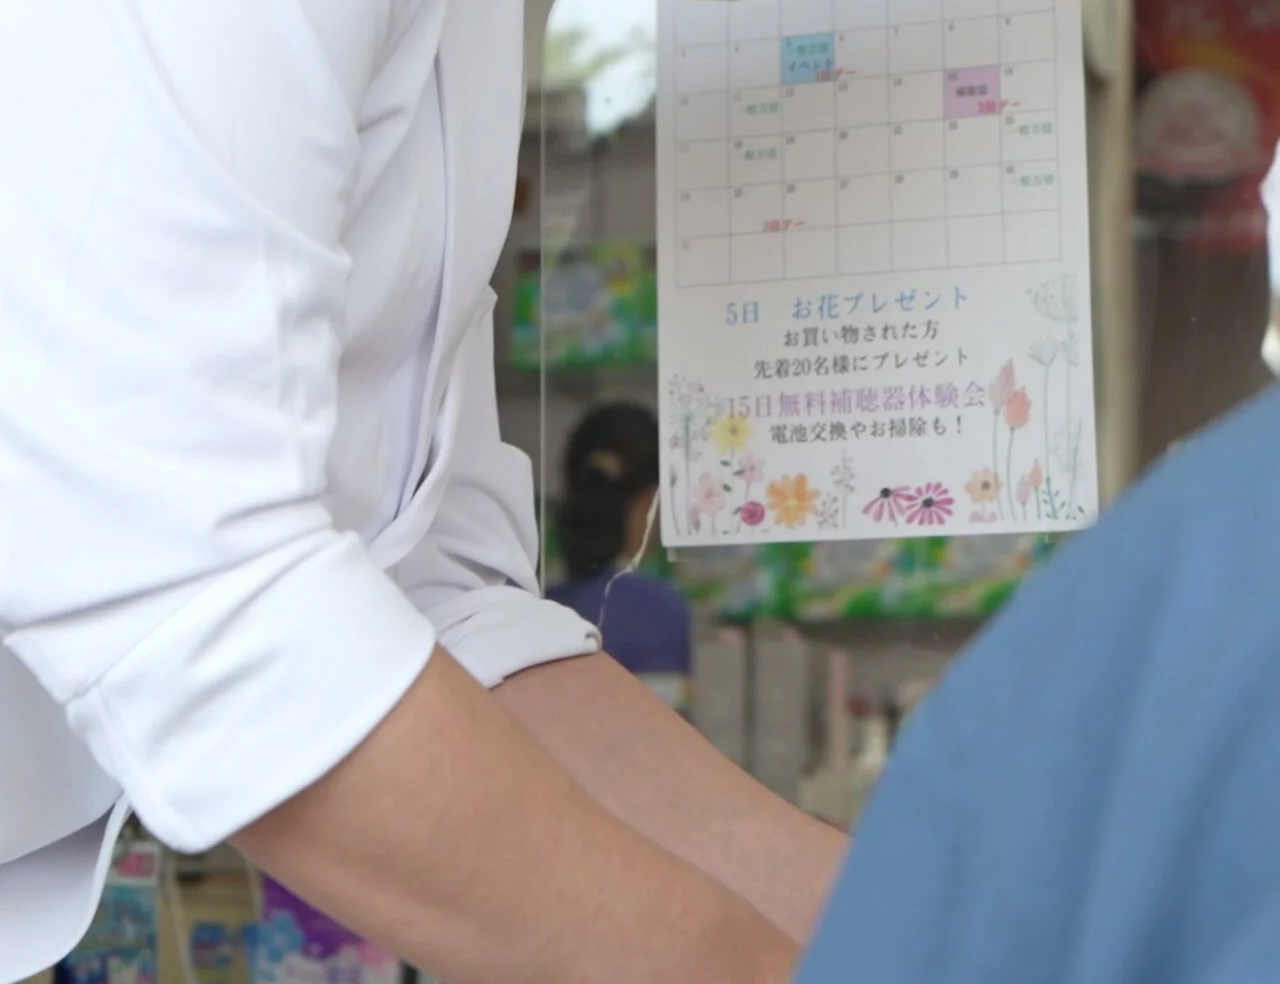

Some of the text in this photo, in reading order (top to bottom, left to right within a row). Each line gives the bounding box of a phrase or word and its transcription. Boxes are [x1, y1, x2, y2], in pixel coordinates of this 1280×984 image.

[787, 57, 835, 73] イベント
[725, 285, 968, 325] 5日 お花プレゼント
[783, 319, 940, 348] お買い物された方
[754, 347, 969, 380] 先着20名様にプレゼント
[727, 379, 987, 419] 15日無料補聴器体験会
